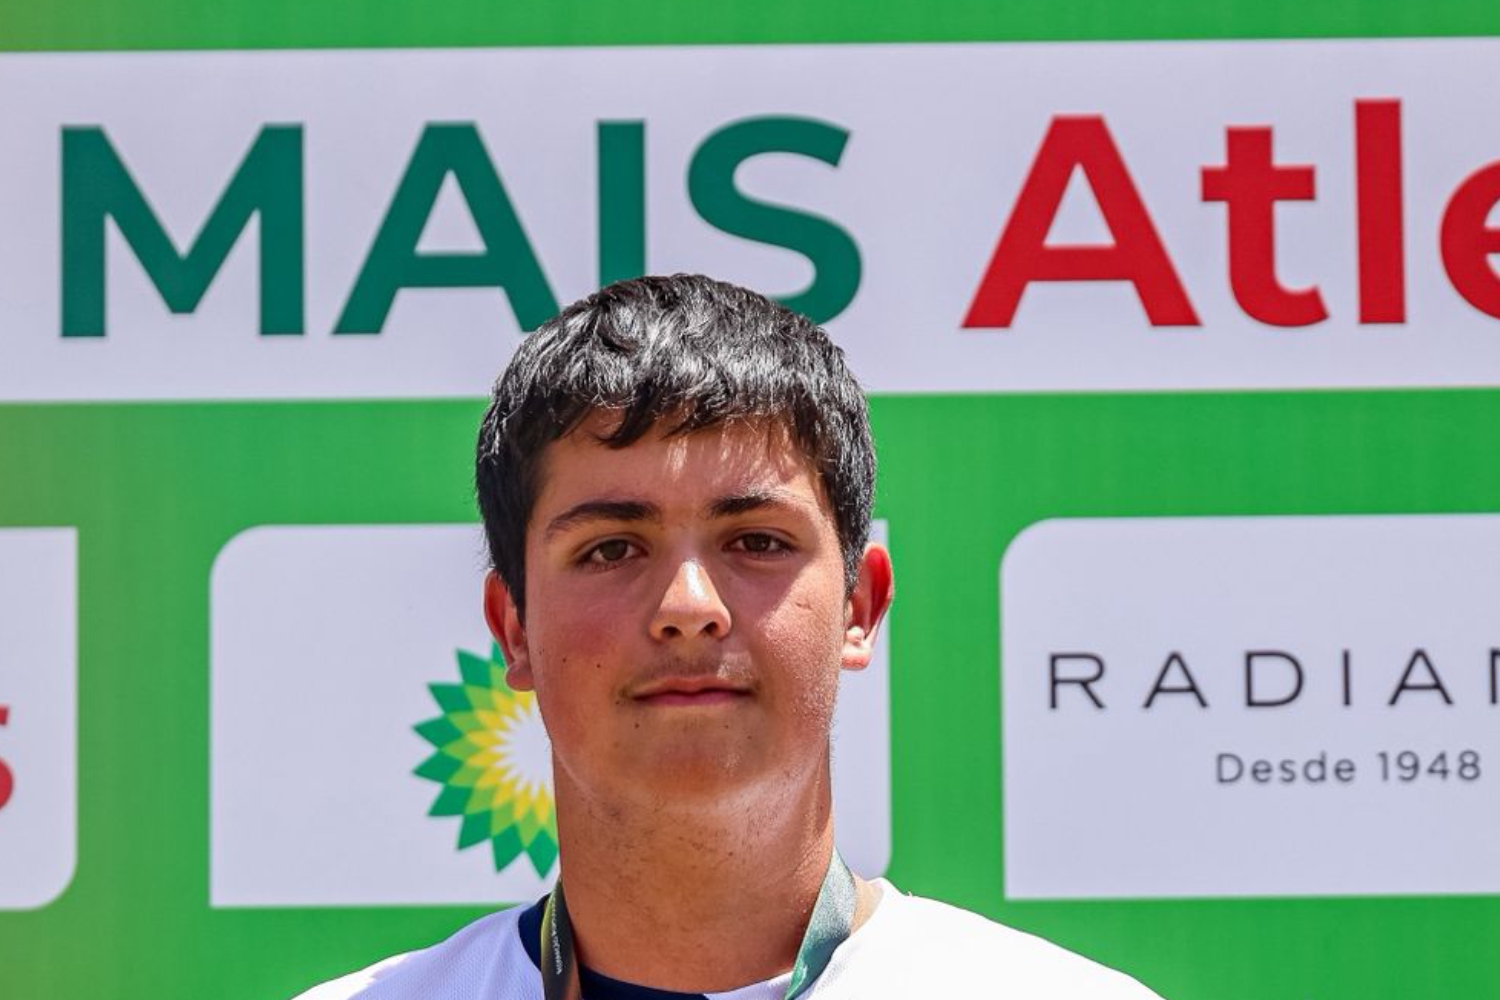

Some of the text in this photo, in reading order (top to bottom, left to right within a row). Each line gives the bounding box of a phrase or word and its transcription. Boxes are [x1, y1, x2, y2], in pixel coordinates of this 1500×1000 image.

[60, 113, 863, 338] MAIS
[1216, 750, 1482, 784] Desde 1948
